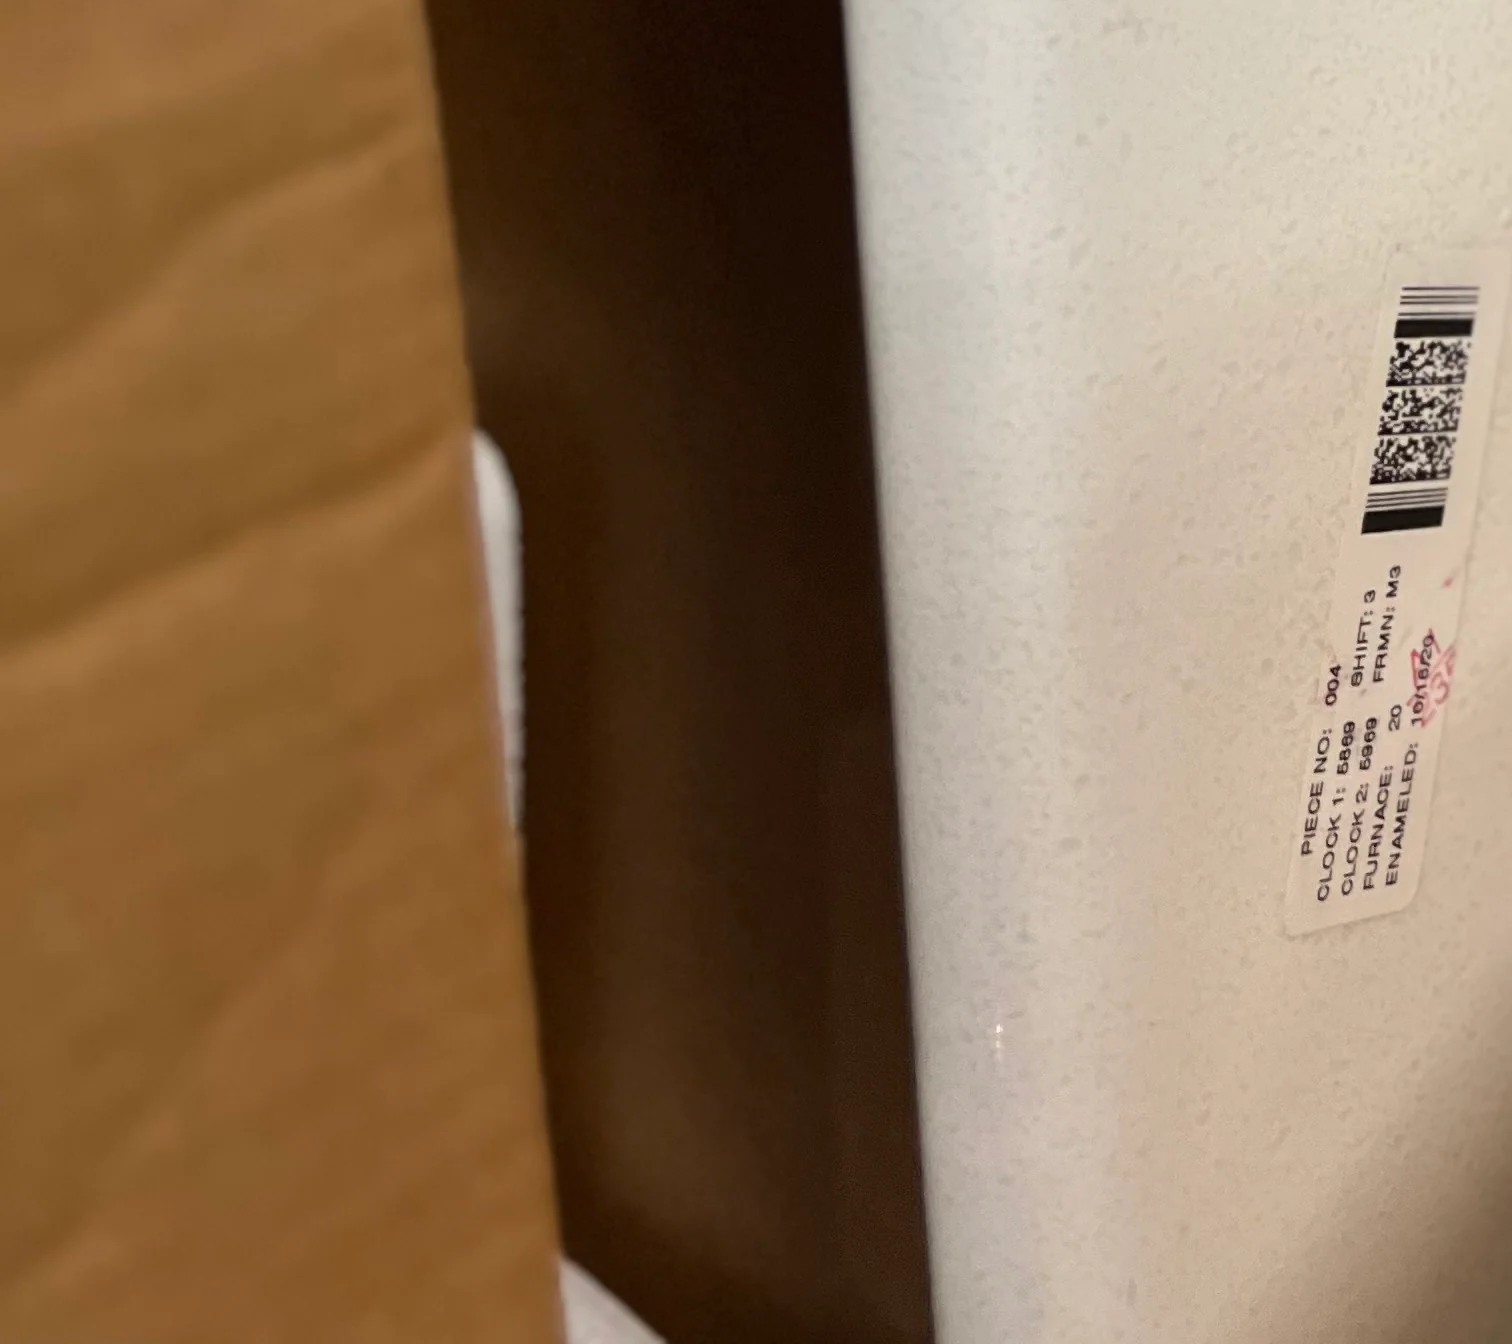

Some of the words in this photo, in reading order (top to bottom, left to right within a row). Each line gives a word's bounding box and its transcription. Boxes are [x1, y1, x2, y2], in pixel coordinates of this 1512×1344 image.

[1301, 783, 1324, 856] PIECE
[1313, 728, 1333, 774] NO:
[1325, 664, 1342, 706] 004
[1317, 814, 1342, 901] CLOCK
[1332, 788, 1347, 807] 1:
[1351, 609, 1374, 687] SHIFT:
[1363, 590, 1376, 605] 3
[1341, 810, 1366, 895] CLOCK
[1355, 783, 1369, 804] 2:
[1372, 607, 1396, 683] FRMN:
[1386, 566, 1402, 599] M3
[1363, 765, 1394, 890] FURNACE:
[1388, 705, 1403, 732] 20
[1385, 743, 1419, 886] ENAMELED:
